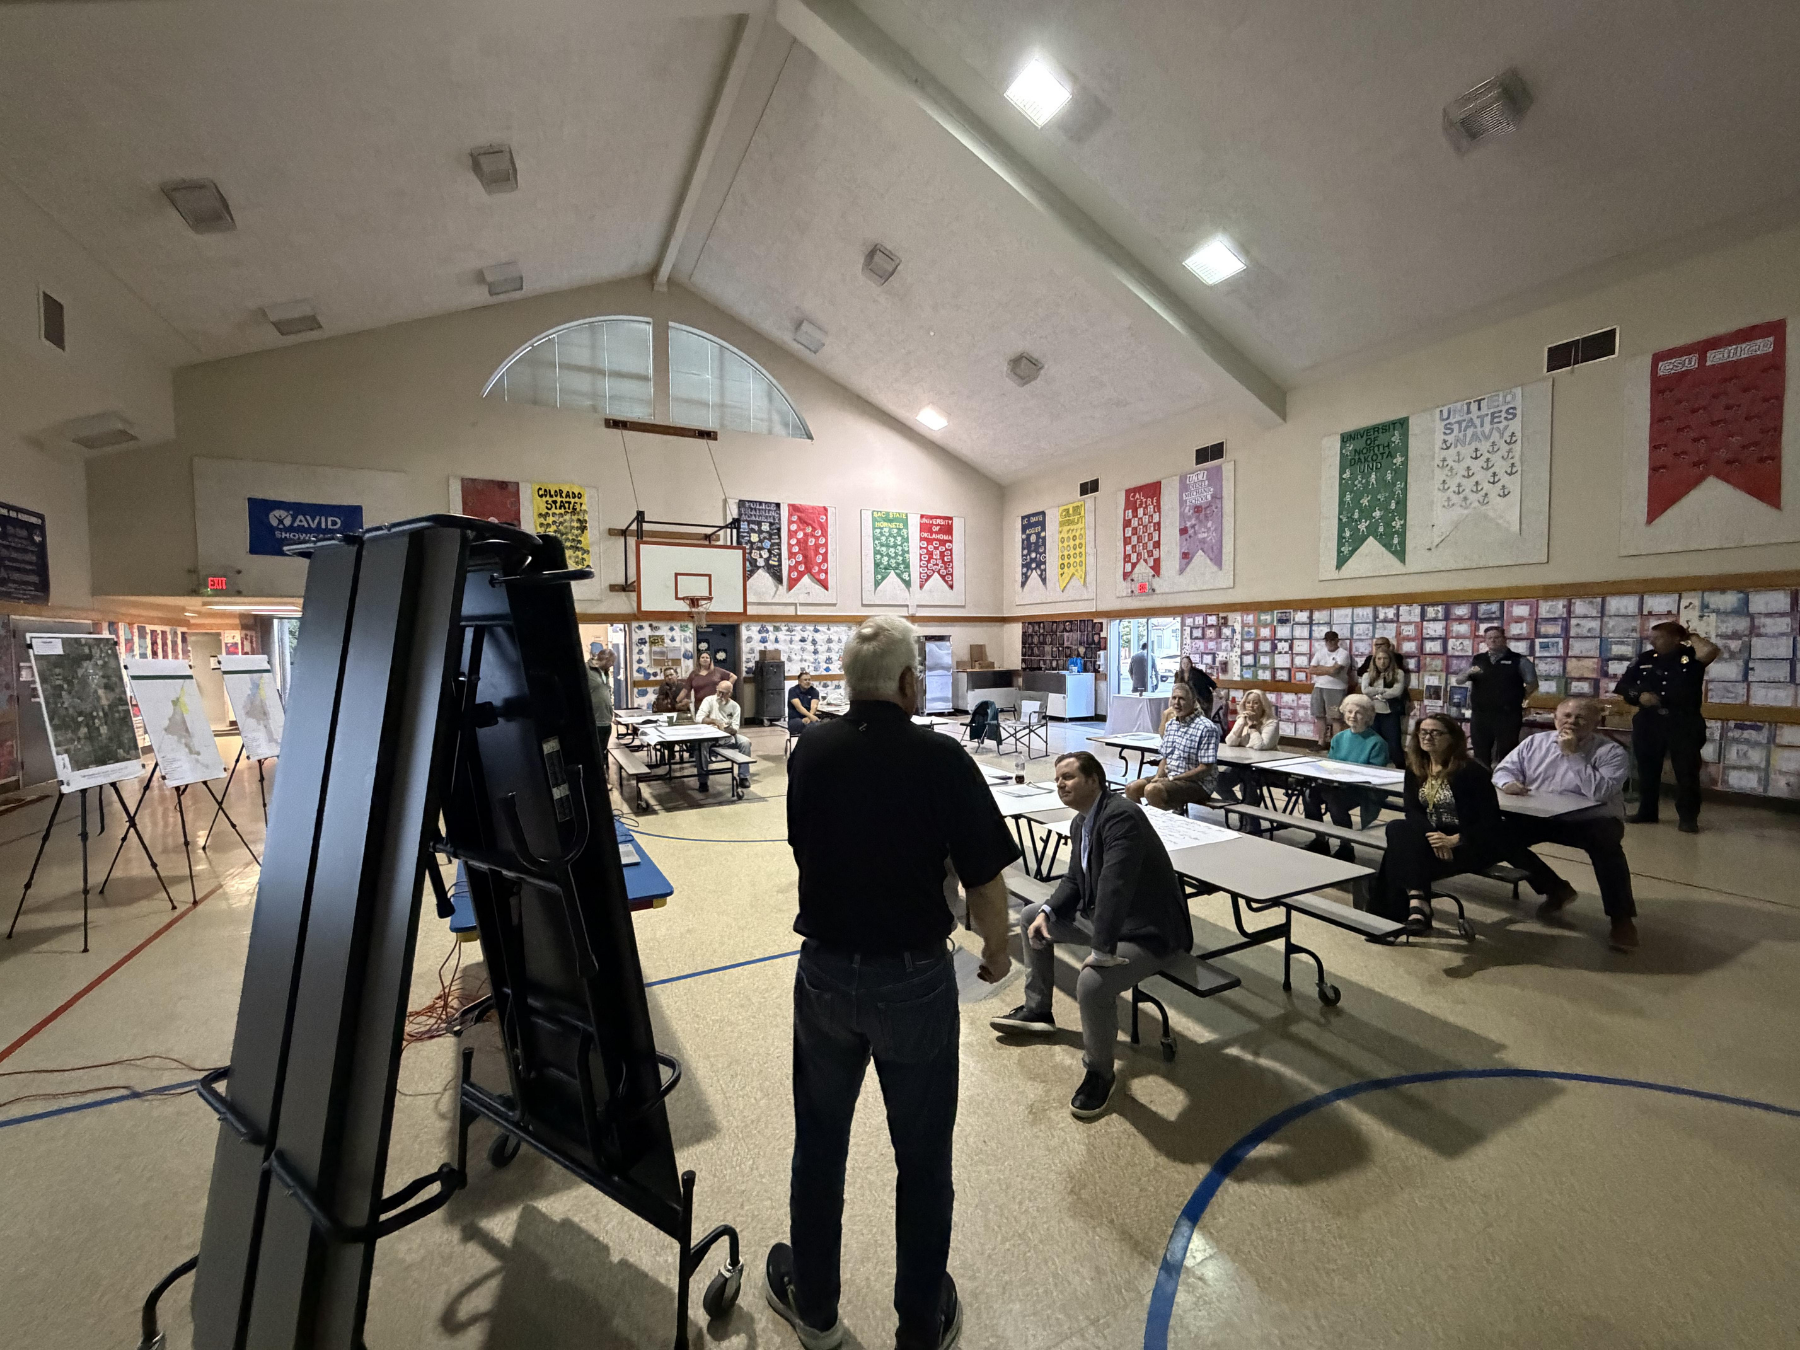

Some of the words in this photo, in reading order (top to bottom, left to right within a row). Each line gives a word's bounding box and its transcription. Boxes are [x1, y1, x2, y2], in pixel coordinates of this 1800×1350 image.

[1659, 355, 1697, 374] csu
[1439, 390, 1517, 422] UNITED
[1442, 406, 1518, 436] STATES
[1342, 420, 1406, 443] UNIVERSITY
[1453, 424, 1510, 448] NAVY
[1365, 436, 1379, 446] OF
[1353, 442, 1391, 456] NORTH
[1349, 451, 1393, 466] DAKOTA
[1358, 462, 1383, 474] UND
[537, 486, 583, 500] COLORADO
[1129, 492, 1144, 500] CAL
[545, 500, 583, 511] STATE!
[745, 501, 777, 511] POLICE
[1136, 497, 1157, 507] FIRE
[739, 507, 780, 517] TRAINING
[293, 514, 342, 530] AVID
[740, 514, 780, 523] ACADEMY
[920, 517, 953, 525] UNIVERSITY
[875, 521, 904, 529] HORNETS
[208, 577, 227, 590] EXIT
